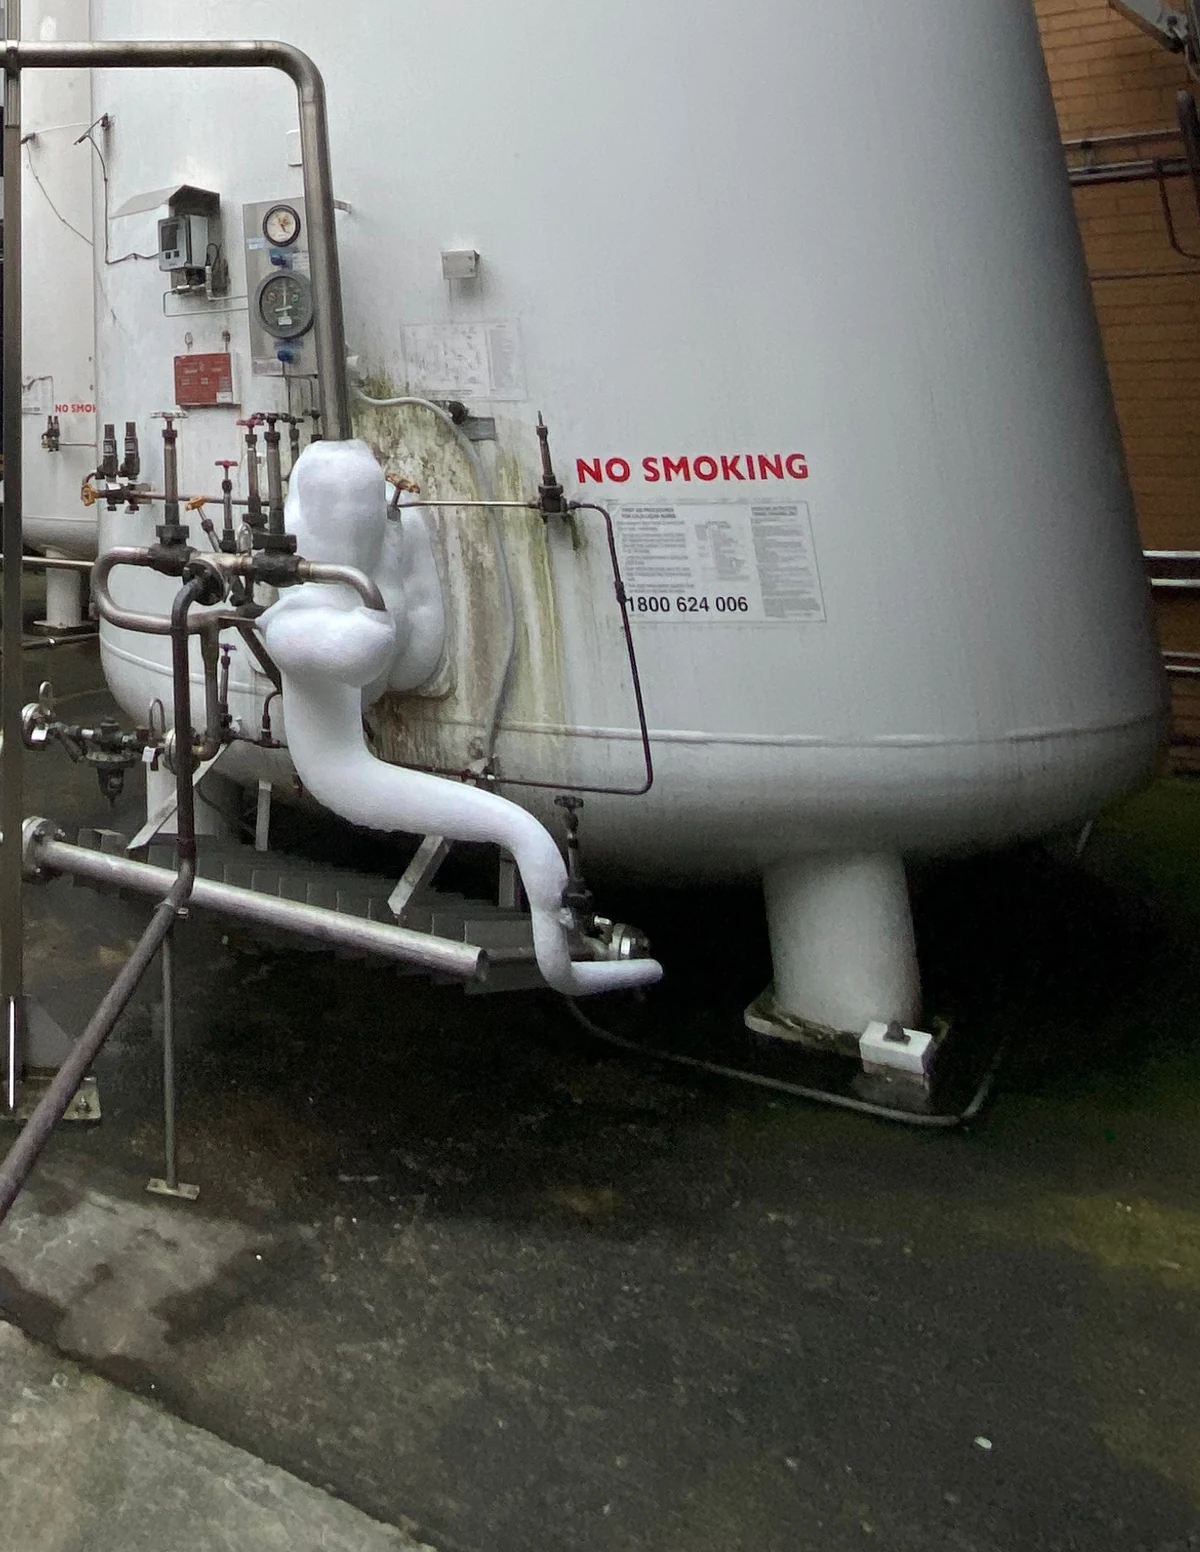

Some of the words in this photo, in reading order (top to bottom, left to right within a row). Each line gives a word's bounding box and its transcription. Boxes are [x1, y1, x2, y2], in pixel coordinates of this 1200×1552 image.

[54, 403, 69, 414] NO
[575, 456, 631, 484] NO
[642, 452, 810, 483] SMOKING
[627, 595, 671, 613] 1800
[676, 595, 710, 613] 624
[714, 595, 749, 613] 006
